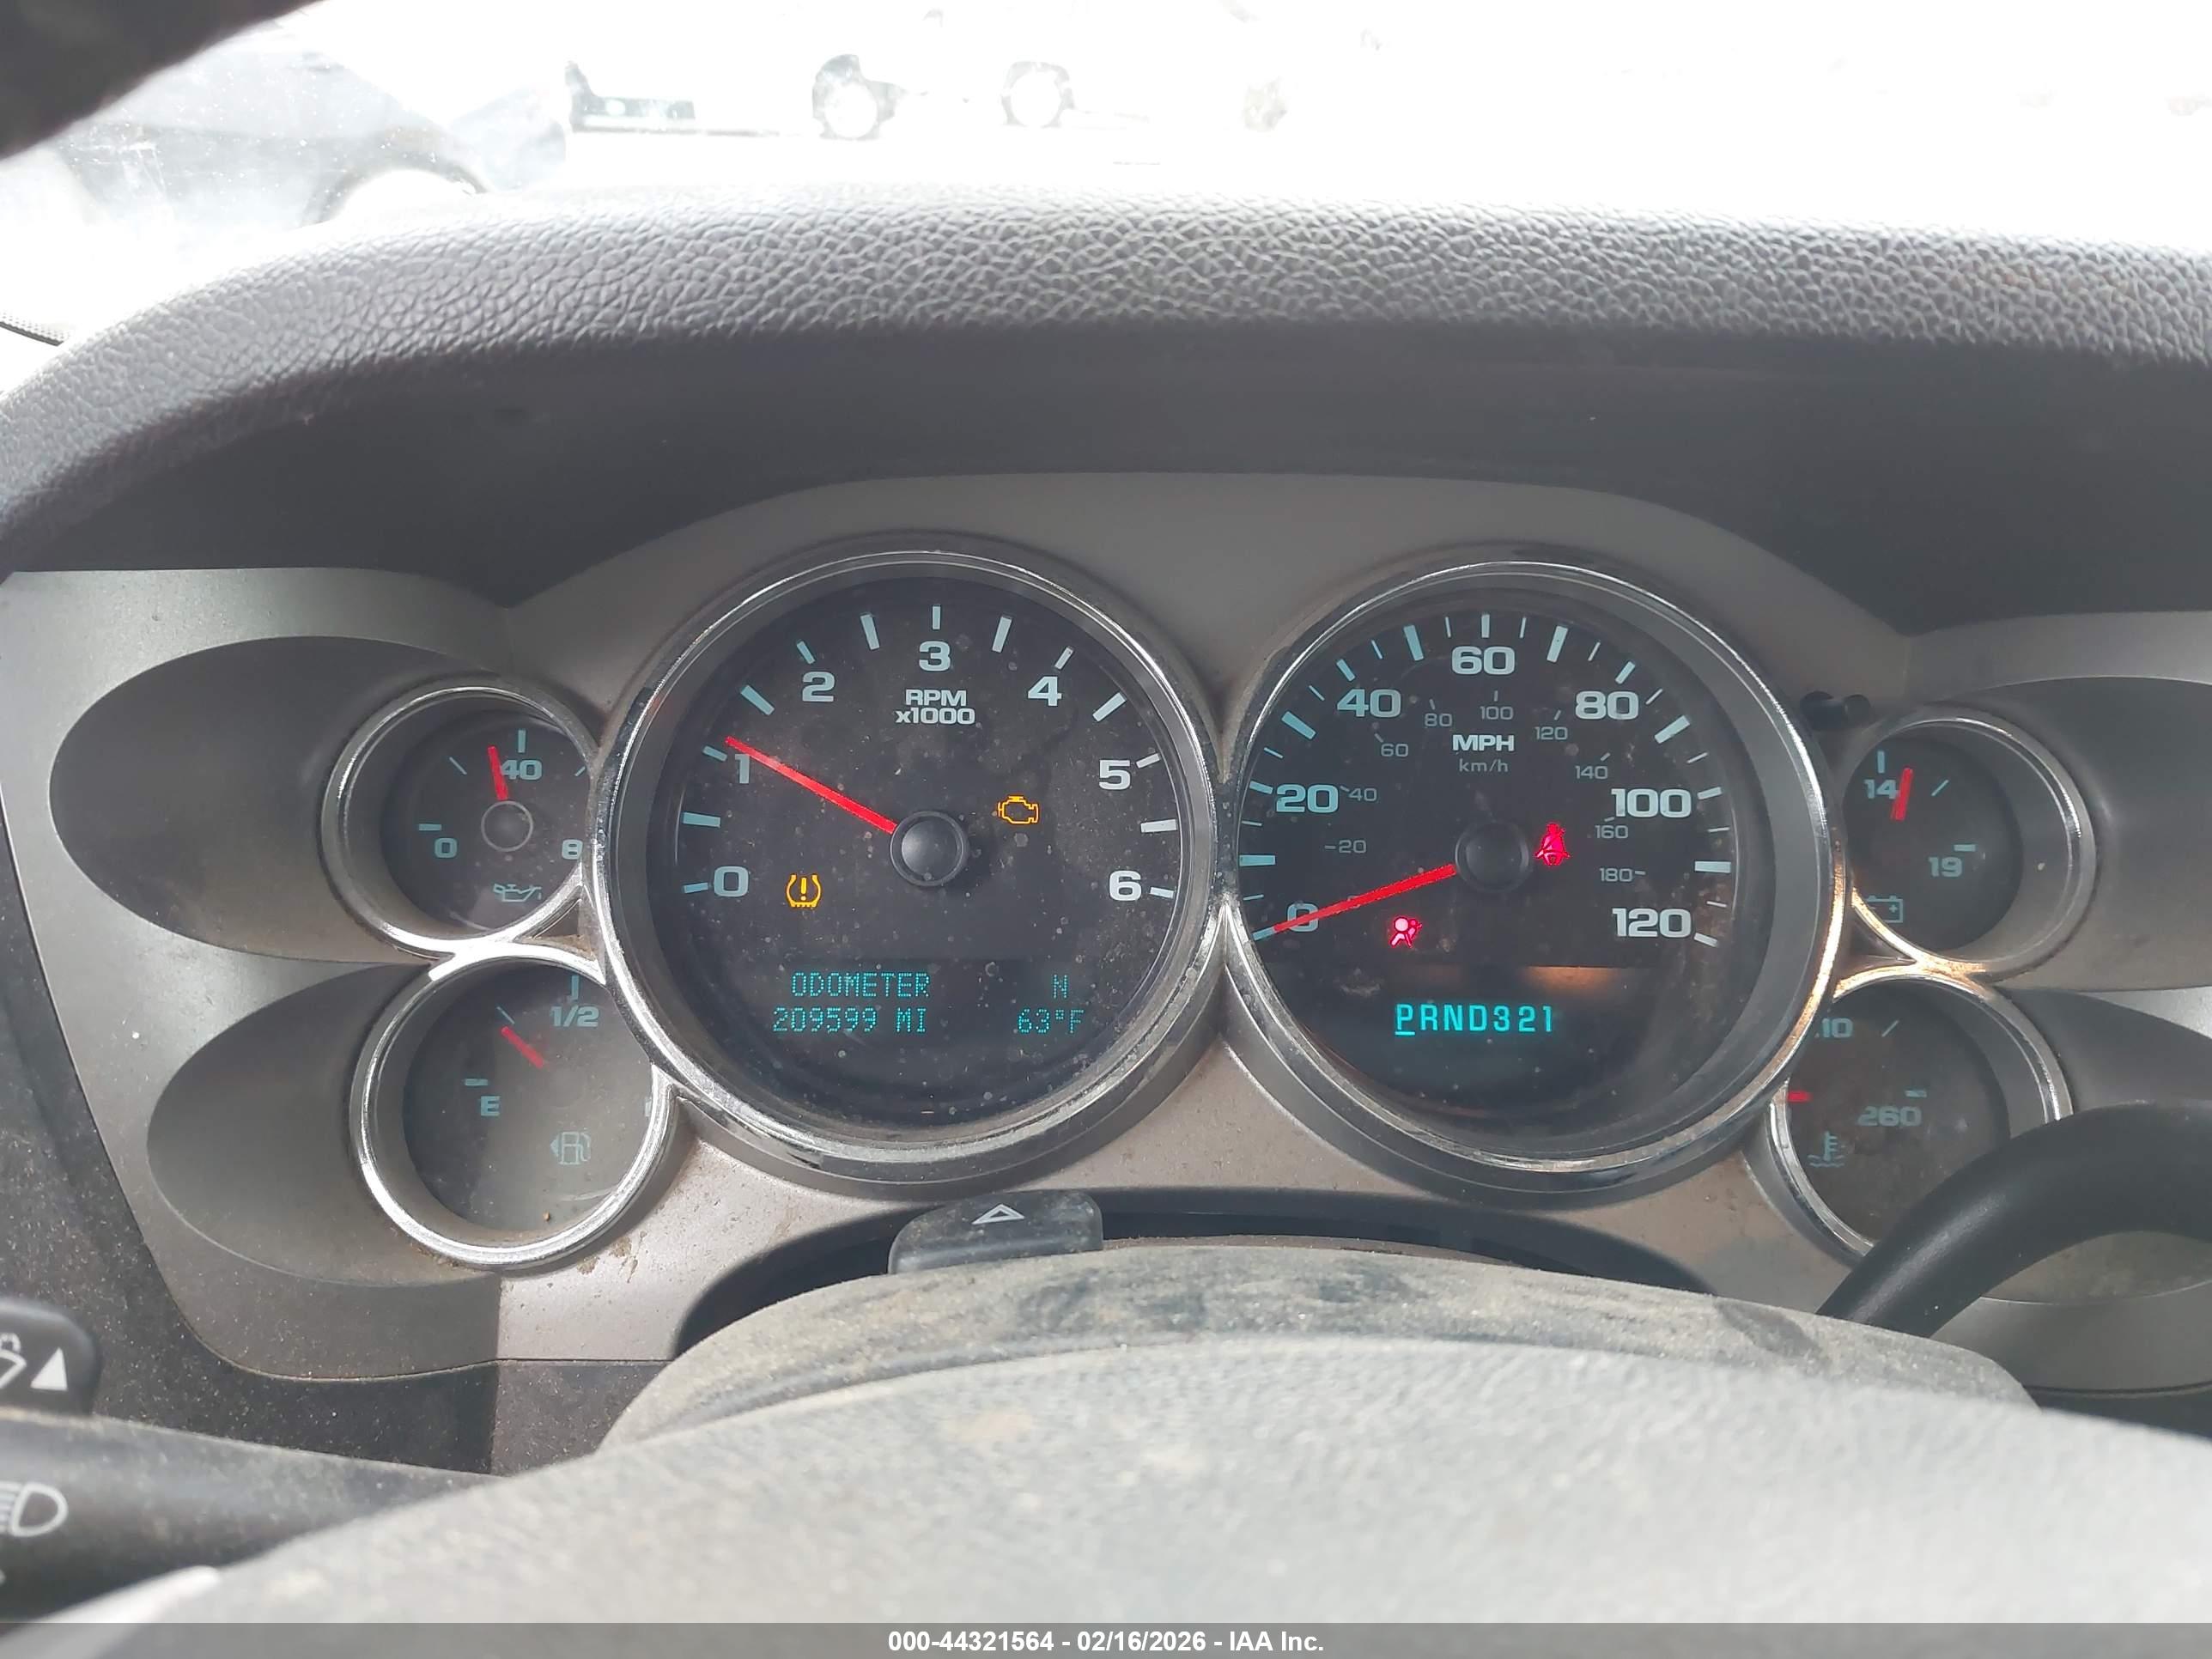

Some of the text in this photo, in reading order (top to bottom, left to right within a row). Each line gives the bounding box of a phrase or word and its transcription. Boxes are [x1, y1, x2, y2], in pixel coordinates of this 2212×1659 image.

[920, 641, 951, 671] 3
[1452, 647, 1515, 674] 60
[803, 672, 835, 702] 2
[1028, 677, 1061, 706] 4
[906, 690, 966, 706] RPM
[1337, 690, 1401, 717] 40
[1576, 691, 1638, 720] 80
[896, 708, 975, 724] x1000
[1425, 714, 1452, 728] 80
[1480, 707, 1513, 720] 100
[1453, 735, 1514, 750] MPH
[1535, 726, 1567, 739] 120
[1381, 744, 1408, 757] 60
[501, 760, 542, 780] 40
[735, 754, 750, 783] 1
[1099, 760, 1130, 789] 5
[1460, 758, 1508, 772] km/h
[1576, 766, 1607, 779] 140
[1276, 785, 1338, 812] 20
[1349, 788, 1376, 801] 40
[1865, 780, 1899, 799] 14
[1611, 789, 1691, 817] 100
[1595, 825, 1628, 838] 160
[434, 838, 457, 858] 0
[1339, 840, 1366, 853] 20
[1600, 868, 1632, 881] 180
[1929, 857, 1962, 877] 19
[714, 866, 749, 896] 0
[1109, 871, 1141, 901] 6
[1287, 903, 1318, 932] 0
[1613, 908, 1691, 937] 120
[793, 973, 929, 996] ODOMETER
[1054, 975, 1066, 998] N
[550, 1006, 599, 1027] 1/2
[774, 1008, 926, 1033] 209599 MI
[1018, 1009, 1084, 1033] 63°F
[1814, 1018, 1853, 1038] 10
[481, 1096, 500, 1116] E
[1858, 1106, 1921, 1126] 260
